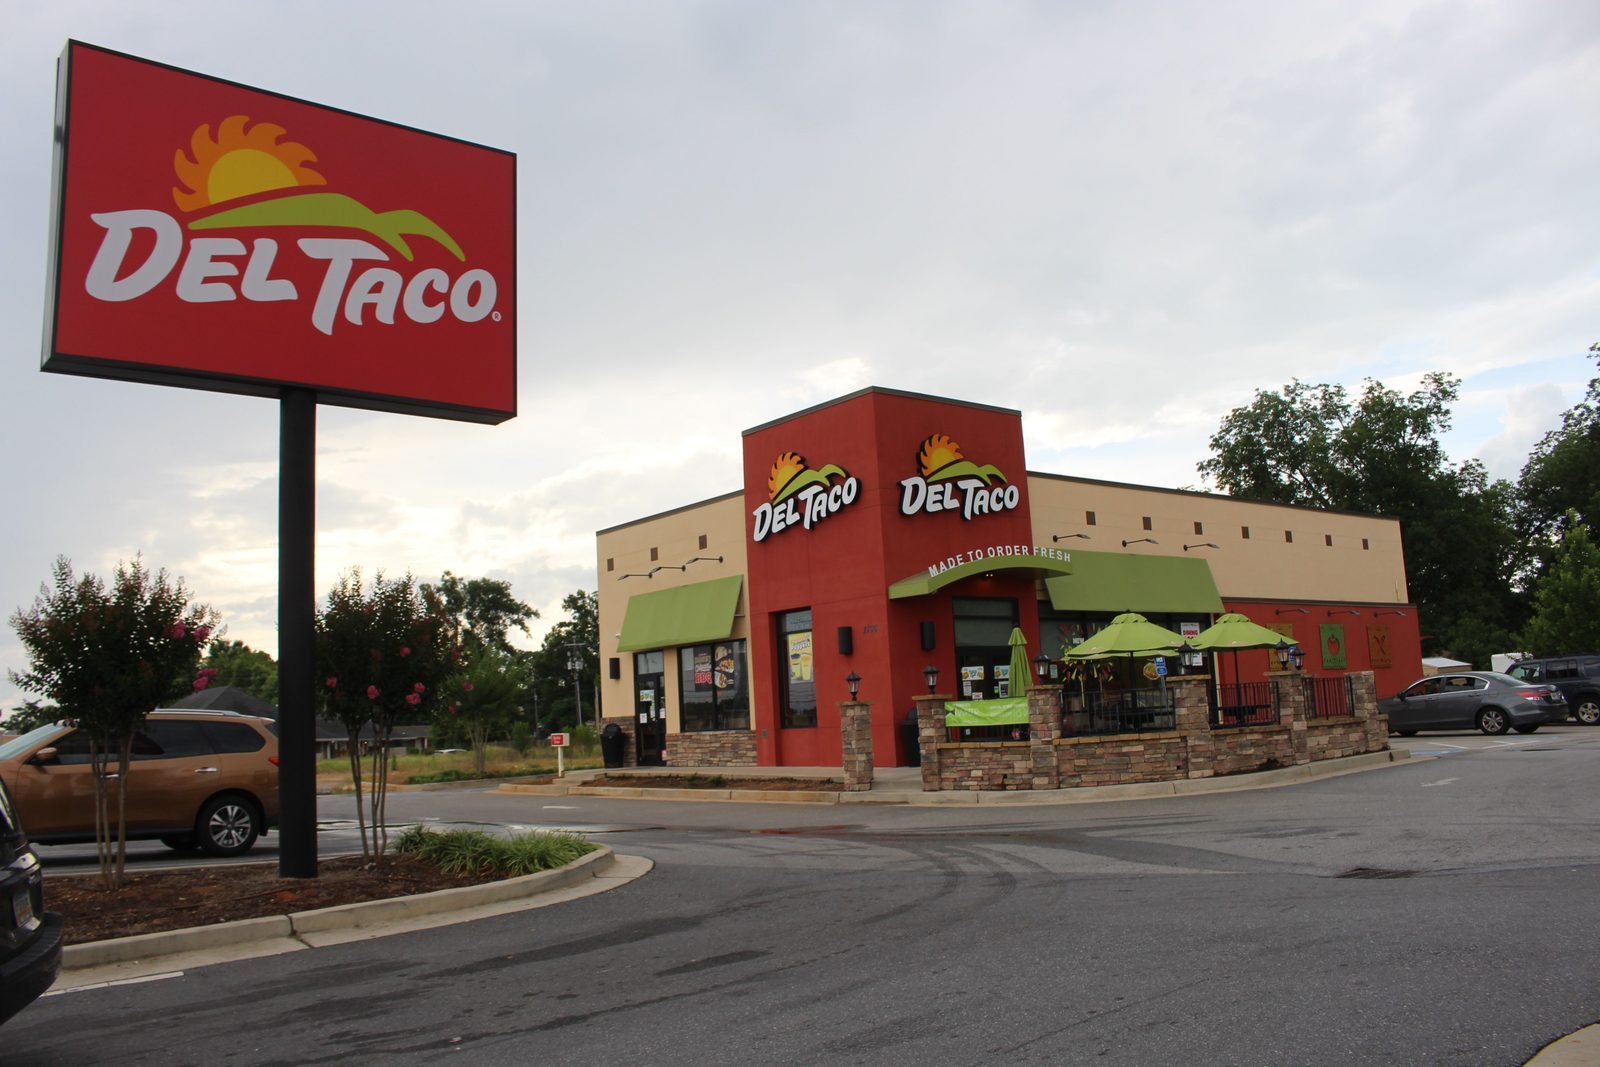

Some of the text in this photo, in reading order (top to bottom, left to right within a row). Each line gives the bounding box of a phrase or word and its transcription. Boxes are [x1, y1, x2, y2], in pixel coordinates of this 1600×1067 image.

[84, 208, 498, 336] DEL TACO
[752, 476, 857, 542] DEL TACO
[900, 476, 1019, 520] DEL TACO
[928, 545, 1071, 577] MADE TO ORDER FRESH
